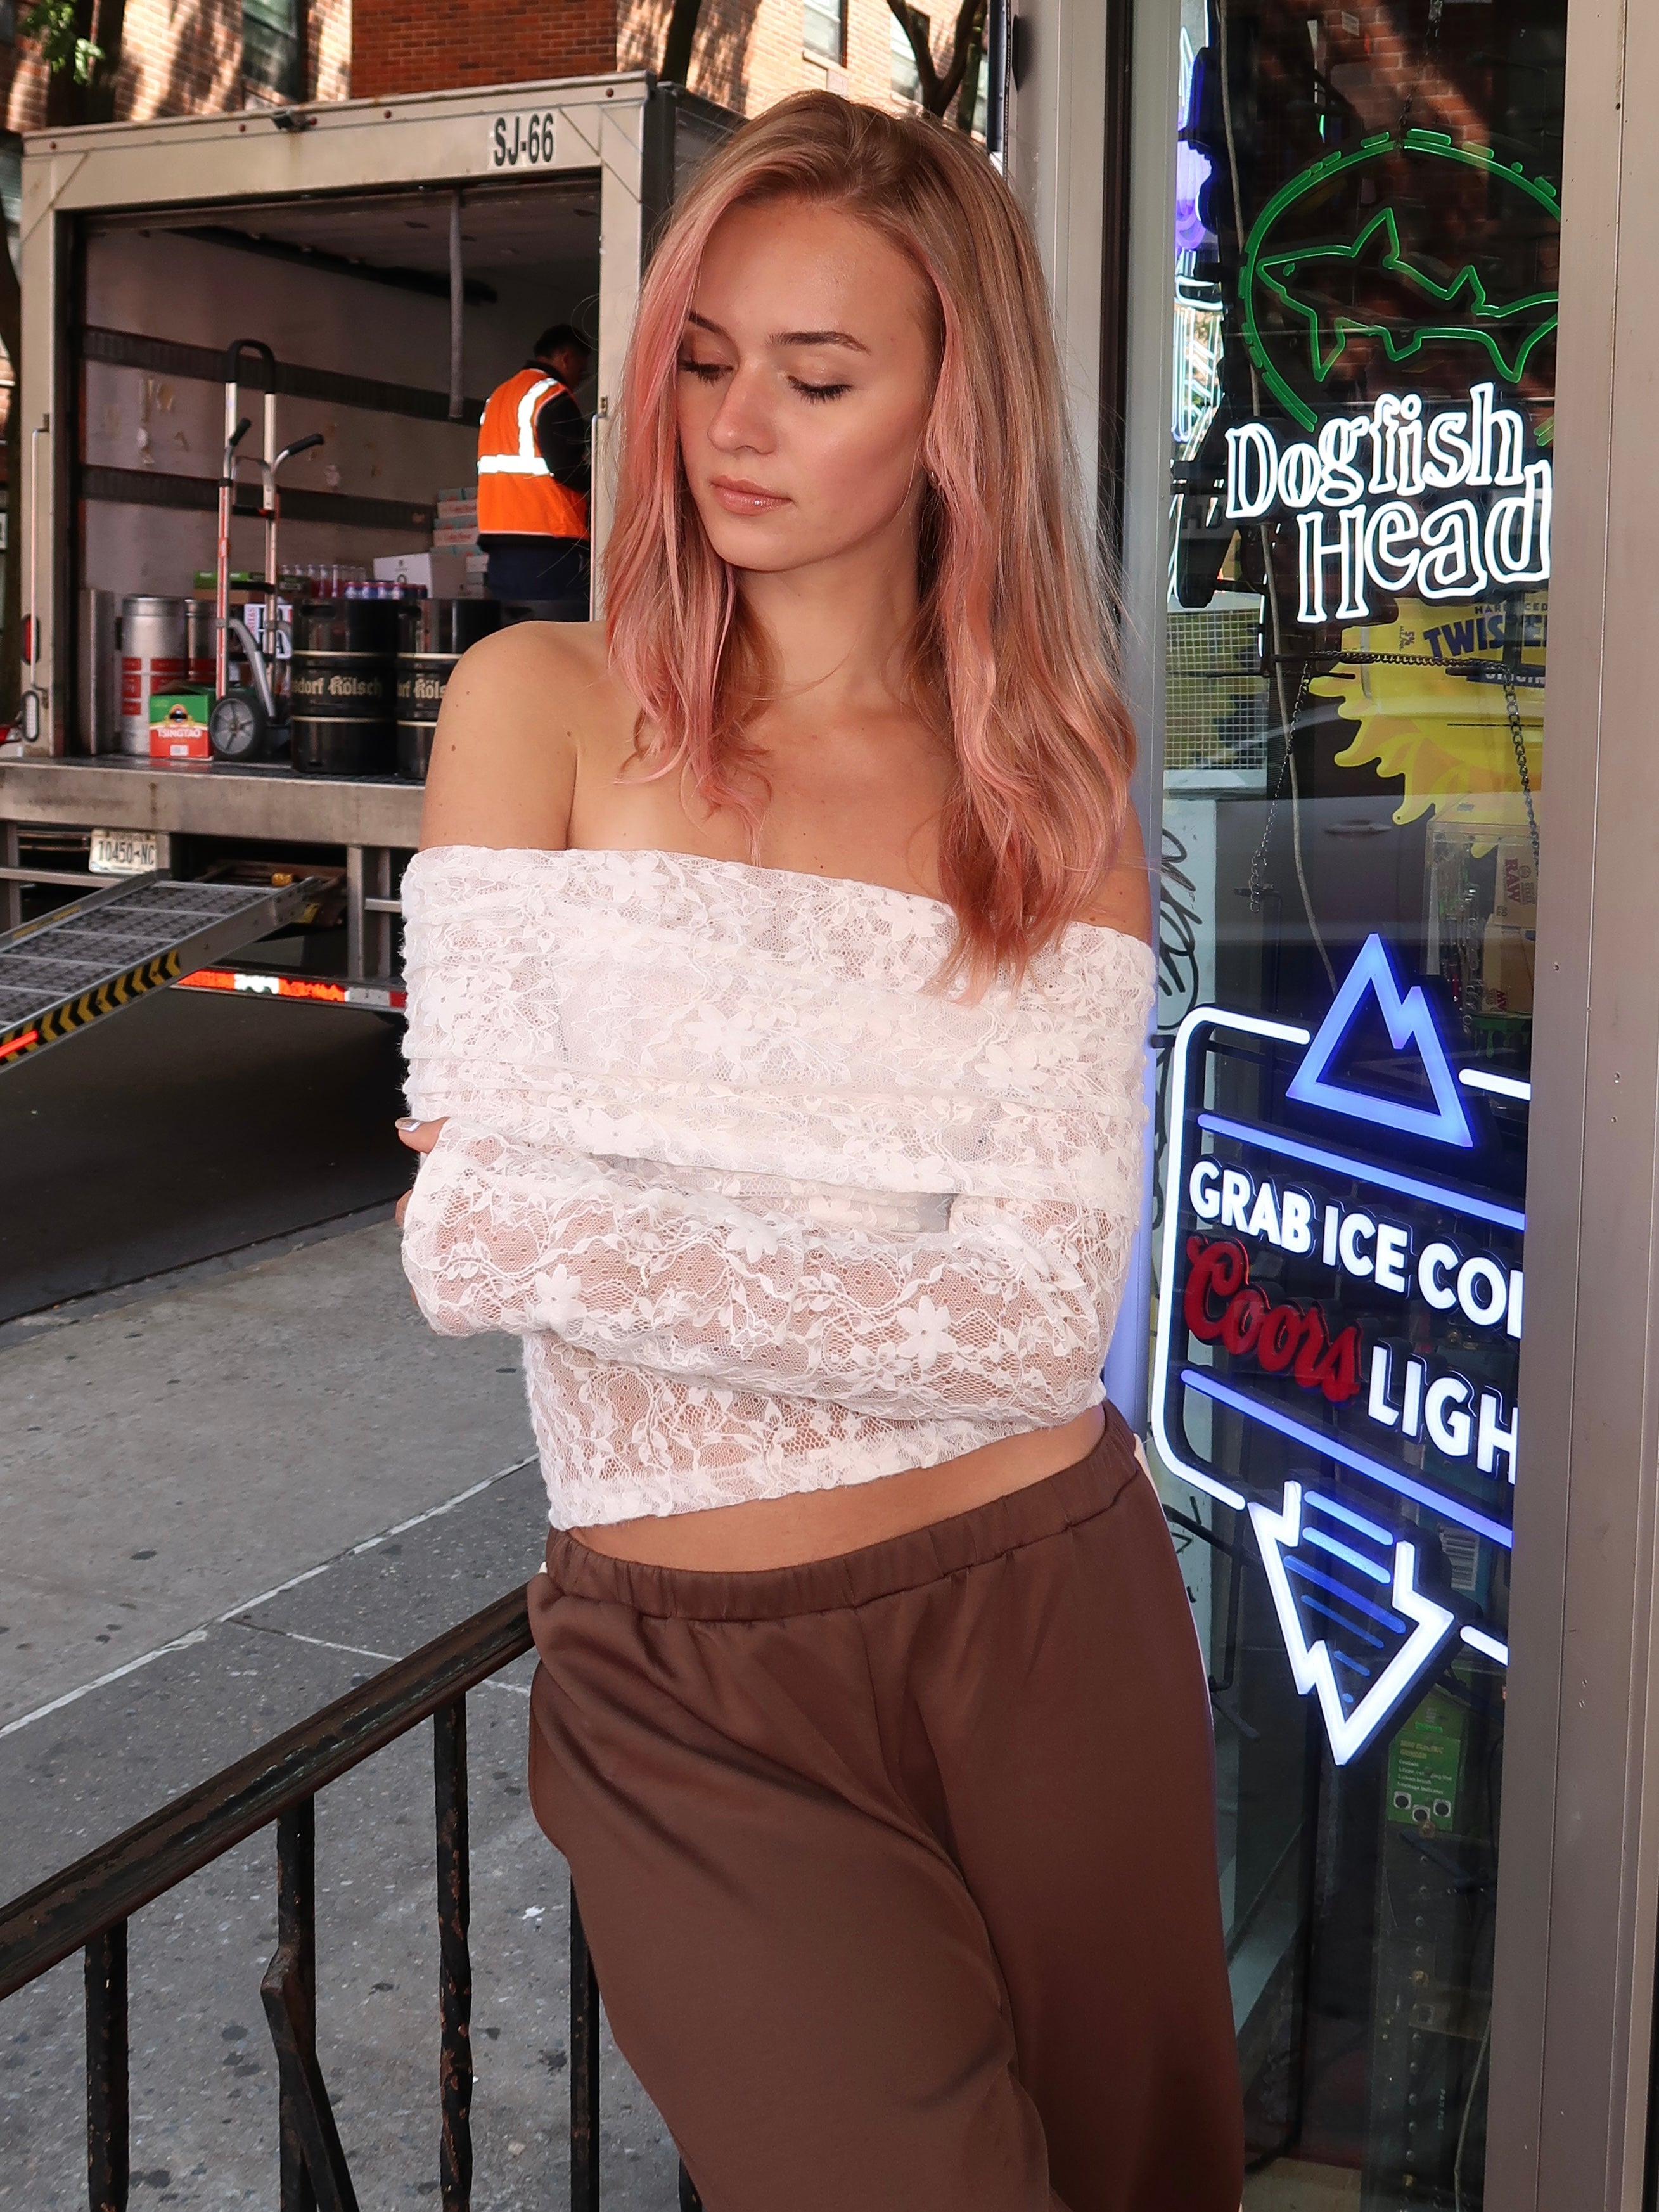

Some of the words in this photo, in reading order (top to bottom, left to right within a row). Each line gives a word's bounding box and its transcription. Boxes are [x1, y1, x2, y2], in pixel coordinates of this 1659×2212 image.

[494, 113, 553, 167] SJ-66
[1224, 382, 1525, 519] Dogfish
[1296, 460, 1553, 624] Head
[1475, 605, 1507, 615] HAR
[157, 728, 202, 738] TSINGTAO
[1504, 858, 1521, 903] RAW
[1189, 1161, 1311, 1254] GRAB
[1323, 1205, 1408, 1293] ICE
[1184, 1236, 1361, 1403] Coors
[1368, 1346, 1518, 1485] LIGH
